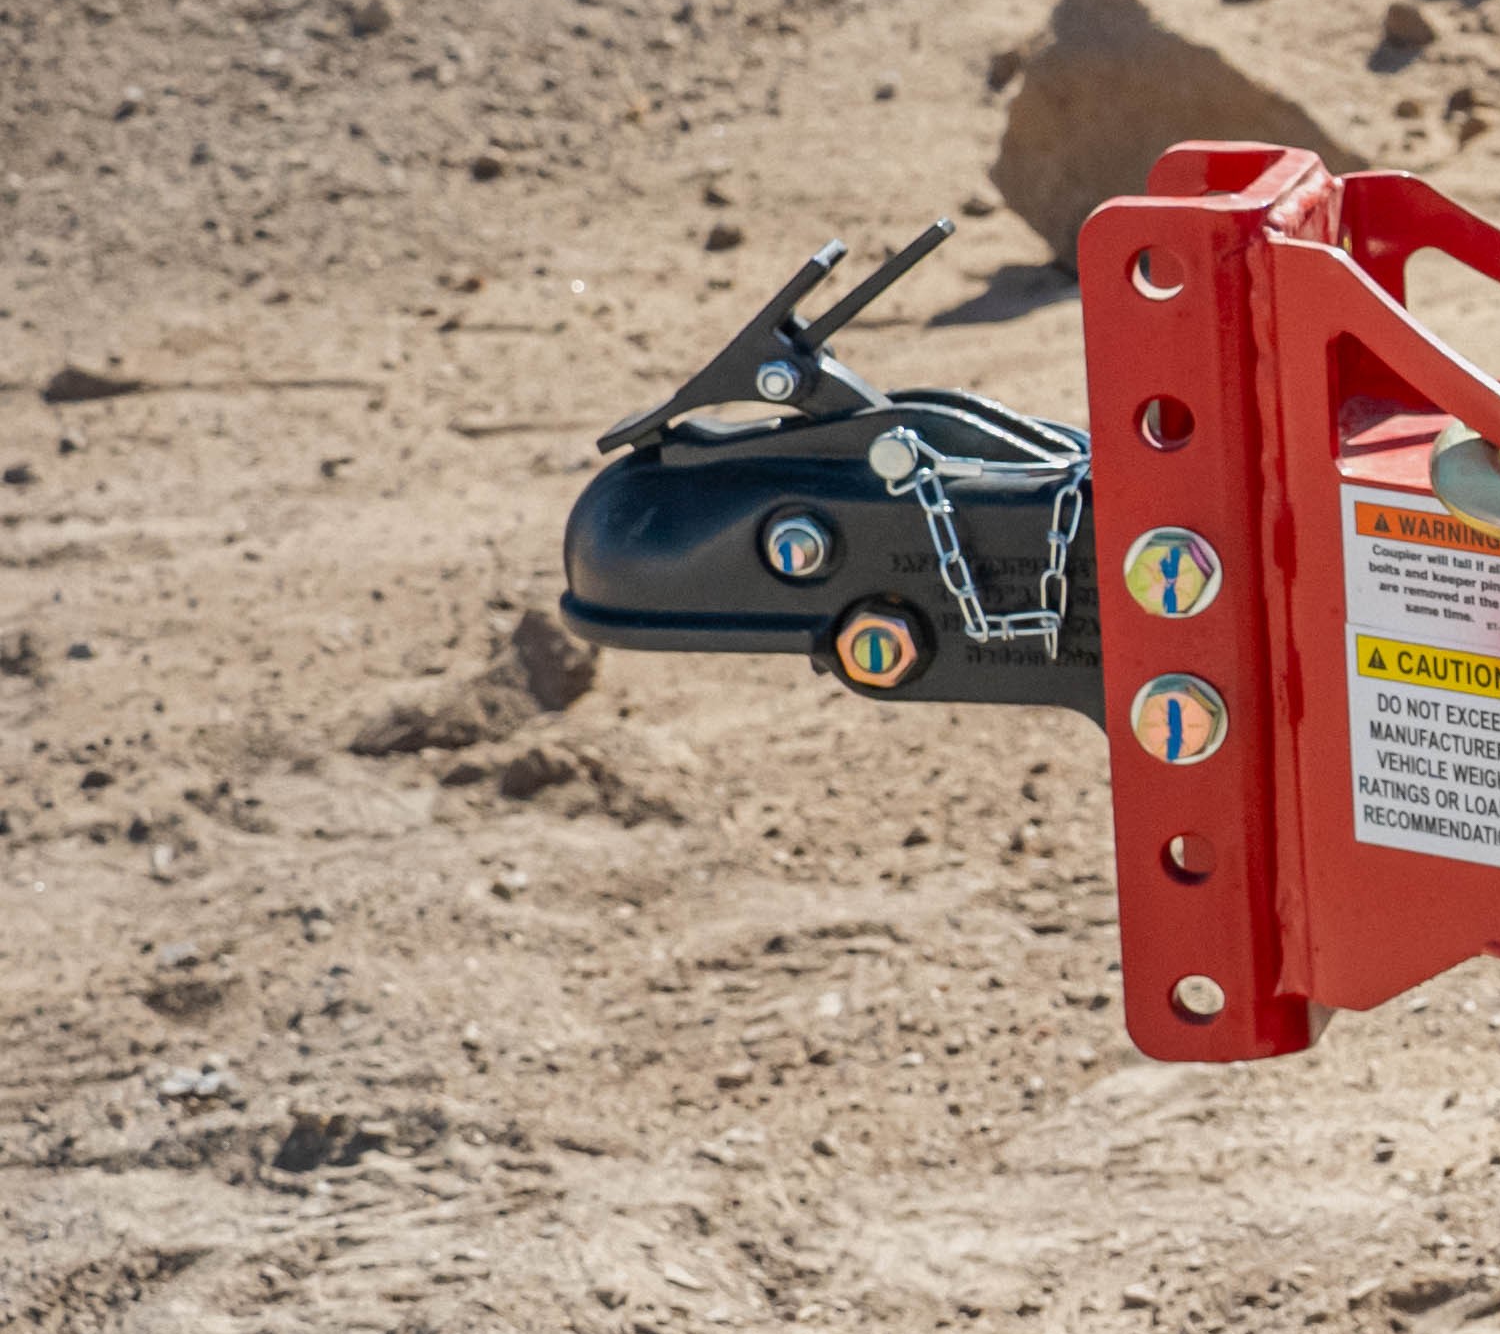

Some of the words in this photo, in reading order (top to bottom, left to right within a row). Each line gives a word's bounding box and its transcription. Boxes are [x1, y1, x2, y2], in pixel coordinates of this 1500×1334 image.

[1371, 543, 1423, 562] Coupler
[1426, 554, 1449, 567] will
[1452, 556, 1473, 570] fail
[1368, 561, 1401, 576] bolts
[1404, 568, 1429, 581] and
[1431, 571, 1477, 589] keeper
[1379, 582, 1400, 594] are
[1403, 586, 1460, 603] removed
[1463, 594, 1476, 606] at
[1478, 596, 1500, 610] the
[1405, 603, 1440, 617] same
[1442, 607, 1474, 623] time.
[1377, 692, 1402, 715] DO
[1406, 698, 1441, 722] NOT
[1376, 749, 1449, 781] VEHICLE
[1358, 775, 1431, 806] RATINGS
[1435, 788, 1460, 811] OR
